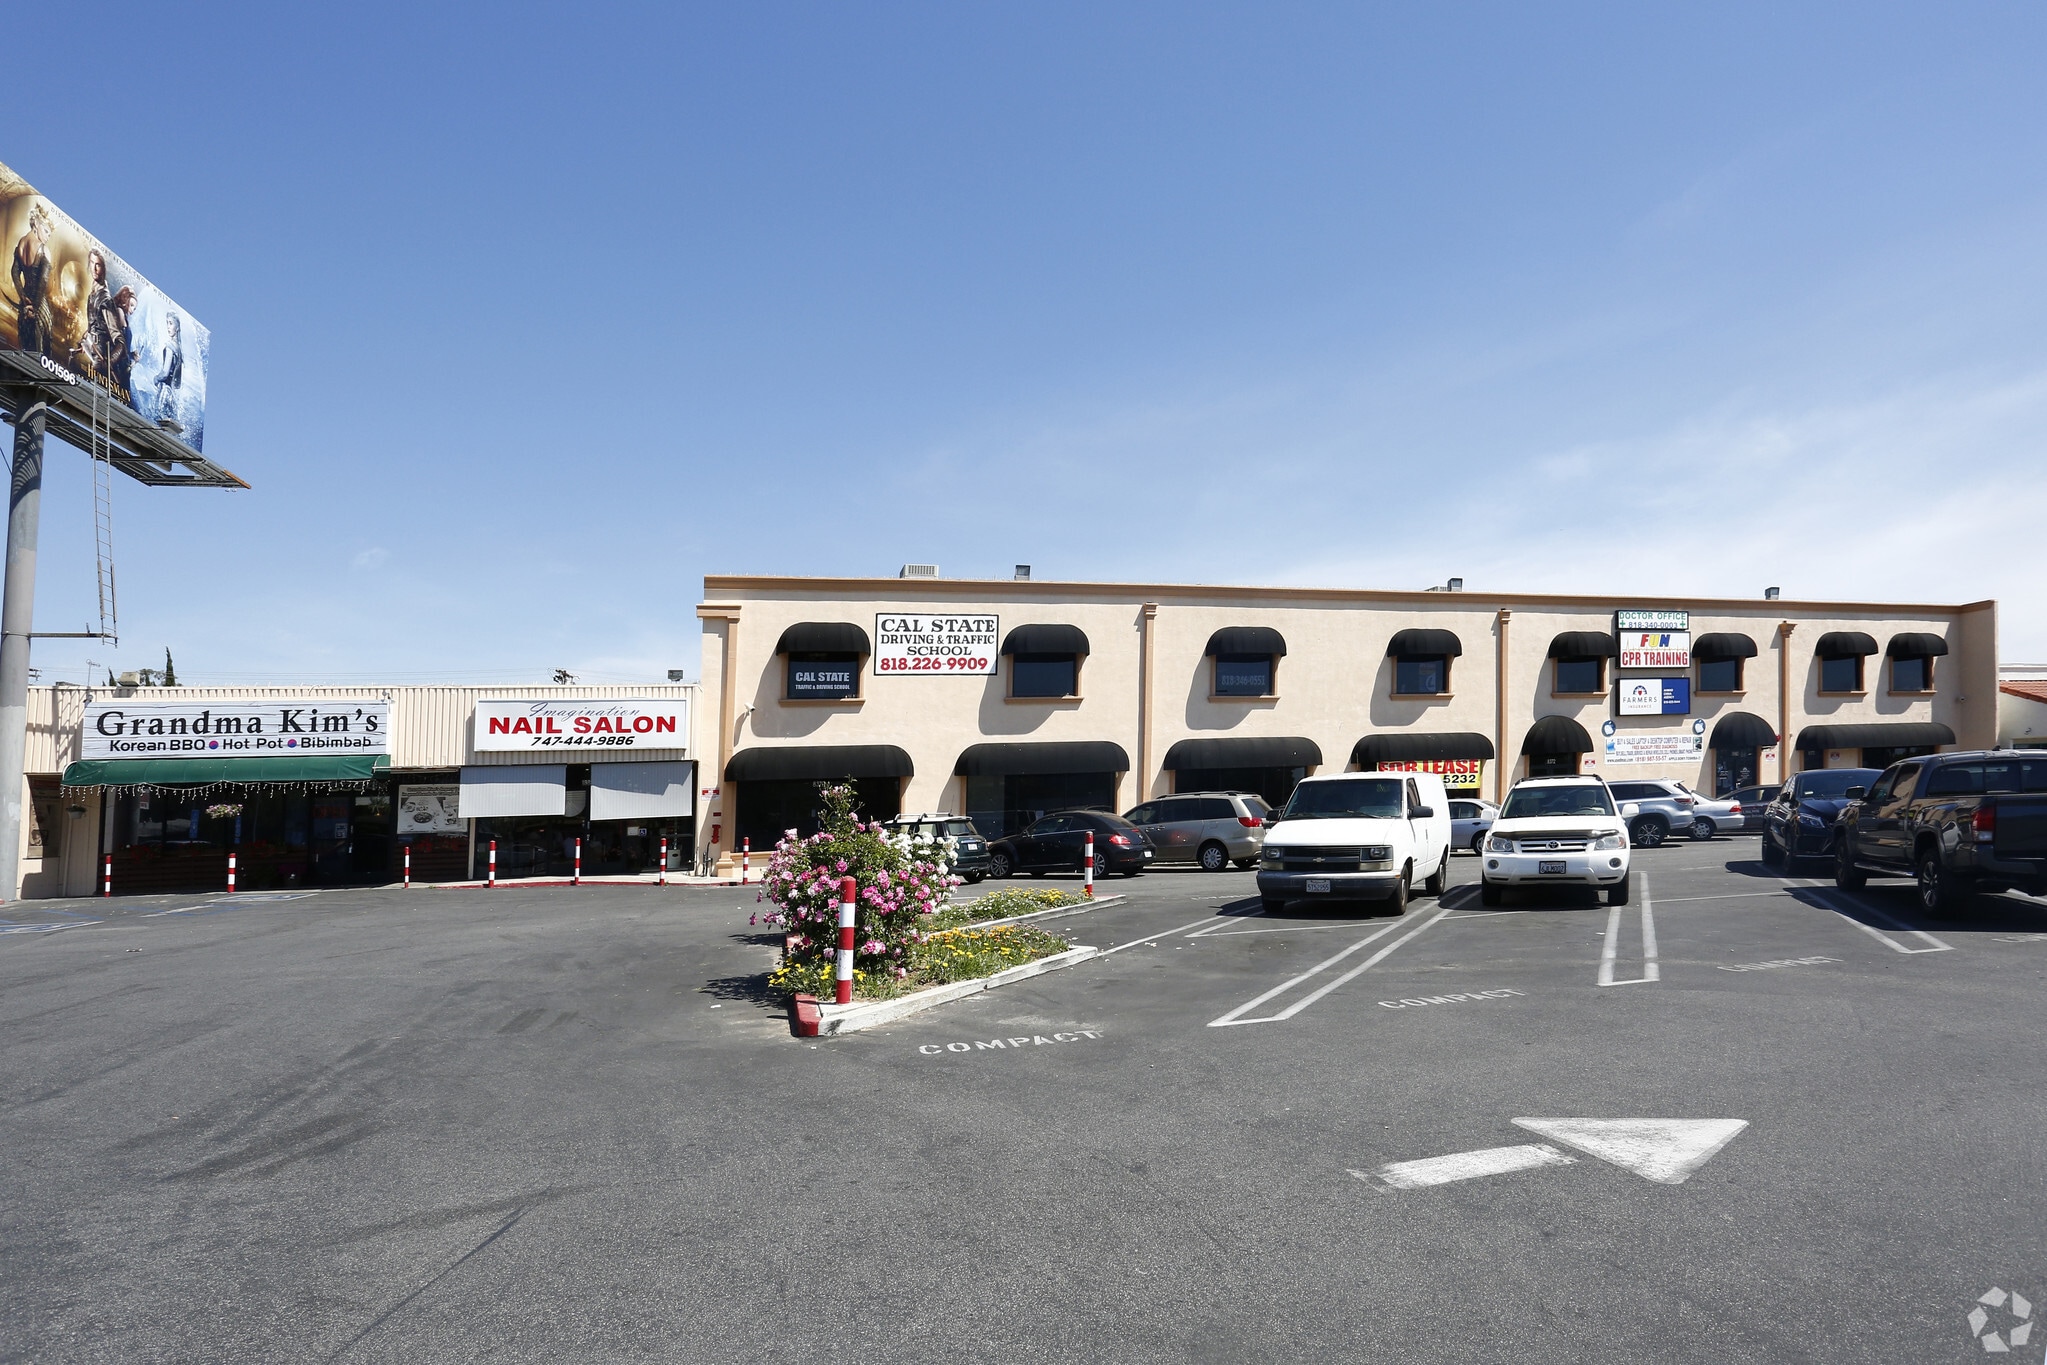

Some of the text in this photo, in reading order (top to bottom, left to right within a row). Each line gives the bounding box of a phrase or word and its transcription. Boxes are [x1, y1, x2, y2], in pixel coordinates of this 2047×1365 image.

[51, 207, 80, 233] DISCOVER
[41, 355, 76, 386] 001596
[1619, 612, 1686, 620] DOCTOR OFFICE
[881, 619, 995, 632] CAL STATE
[1628, 621, 1678, 629] 818-340-0003
[881, 634, 995, 644] DRIVING & TRAFFIC
[1640, 634, 1671, 647] FUN
[907, 646, 972, 656] SCHOOL
[880, 657, 988, 670] 818.226-9909
[1622, 652, 1688, 666] CPR TRAINING
[795, 672, 850, 681] CAL STATE
[530, 701, 640, 722] Imagination
[96, 708, 378, 736] Grandma Kim's
[489, 716, 676, 734] NAIL SALON
[110, 740, 166, 751] Korean
[169, 740, 206, 751] BBQ
[223, 739, 250, 750] Hot
[256, 738, 283, 749] Pot
[531, 736, 635, 746] 747-444-9886
[1378, 759, 1478, 774] FOR LEASE
[1443, 775, 1476, 783] 5232
[1378, 988, 1527, 1009] COMPACT
[918, 1030, 1105, 1055] COMPACT
